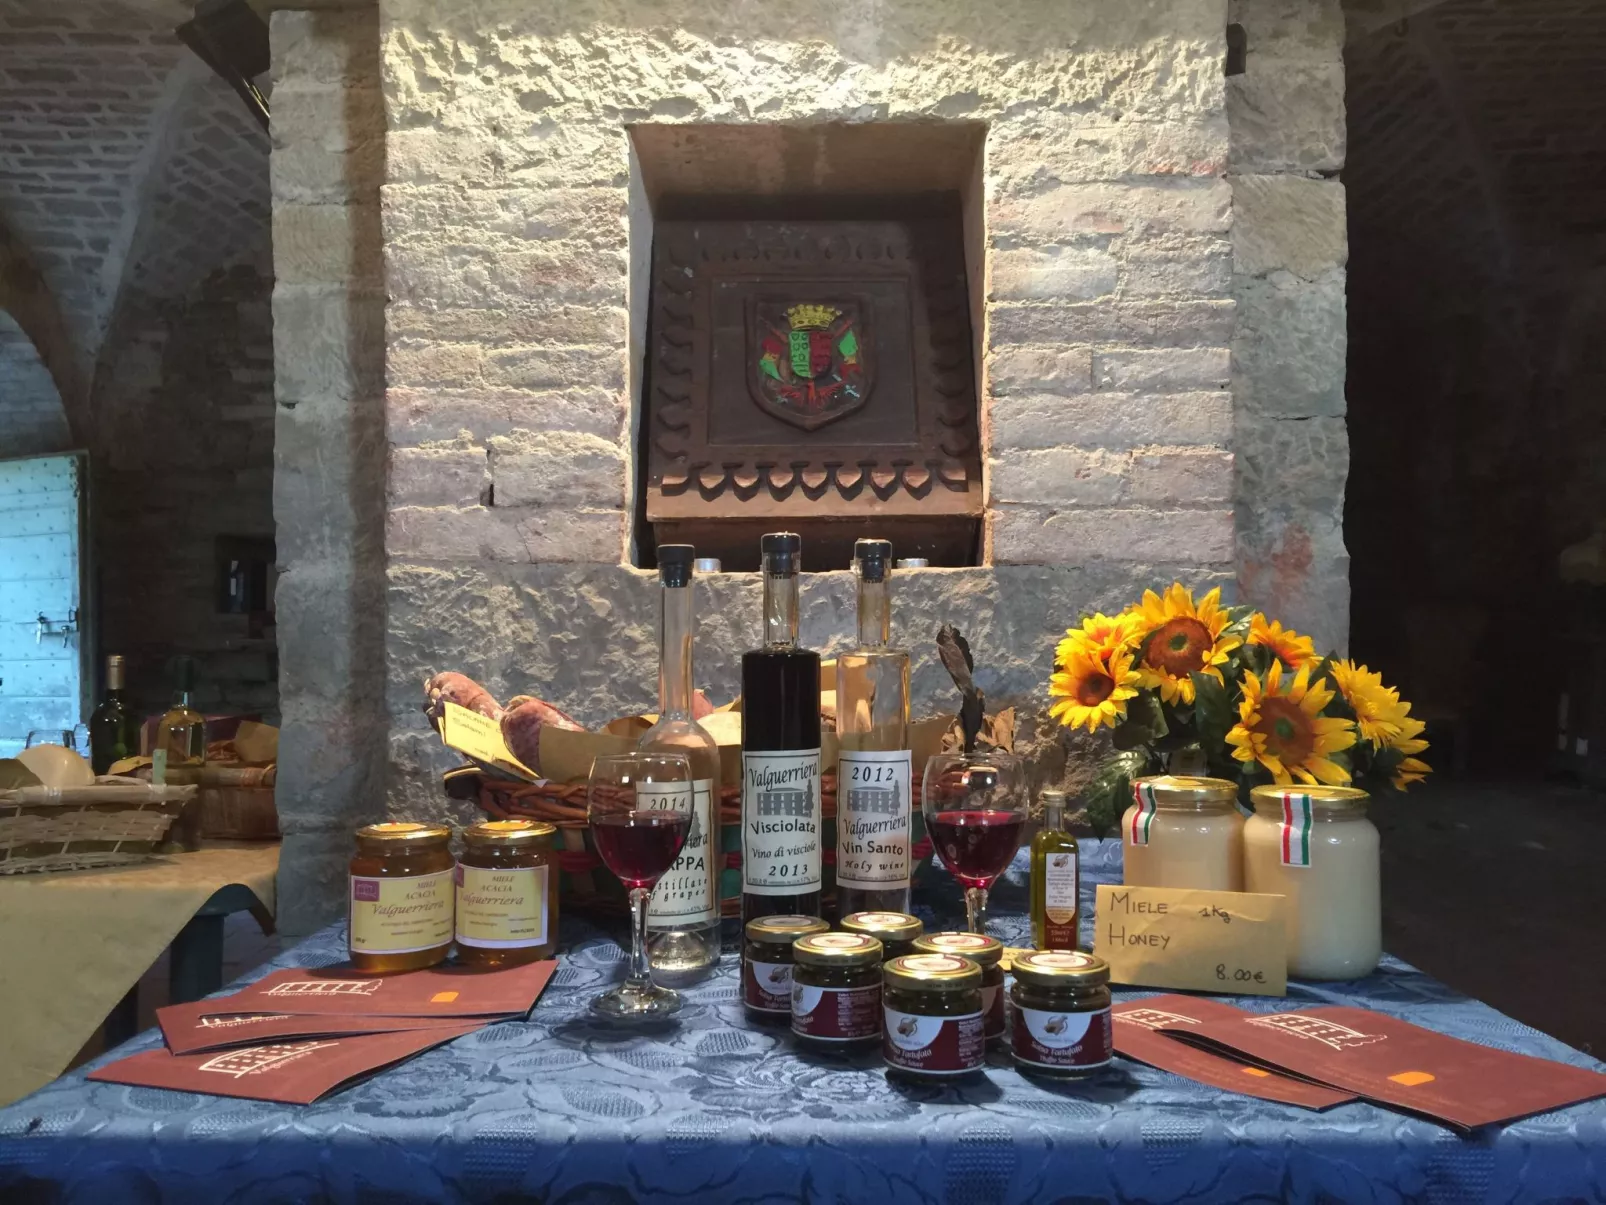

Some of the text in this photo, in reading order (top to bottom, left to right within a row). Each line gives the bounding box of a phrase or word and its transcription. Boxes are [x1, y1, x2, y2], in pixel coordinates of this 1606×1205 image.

[749, 762, 817, 792] Valguerriera
[852, 766, 894, 782] 2012
[650, 797, 686, 811] 2014
[751, 819, 816, 835] Visciolata
[843, 815, 906, 840] Valguerriera
[752, 841, 816, 859] Vino di visciole
[842, 840, 904, 856] Vin Santo
[671, 856, 705, 871] PPA
[768, 864, 808, 877] 2013
[845, 859, 905, 873] Holy wine
[480, 884, 513, 893] ACACIA
[658, 876, 707, 891] stillate
[404, 890, 436, 900] ACACIA
[664, 889, 705, 902] grapes
[371, 900, 444, 918] Valguerriera
